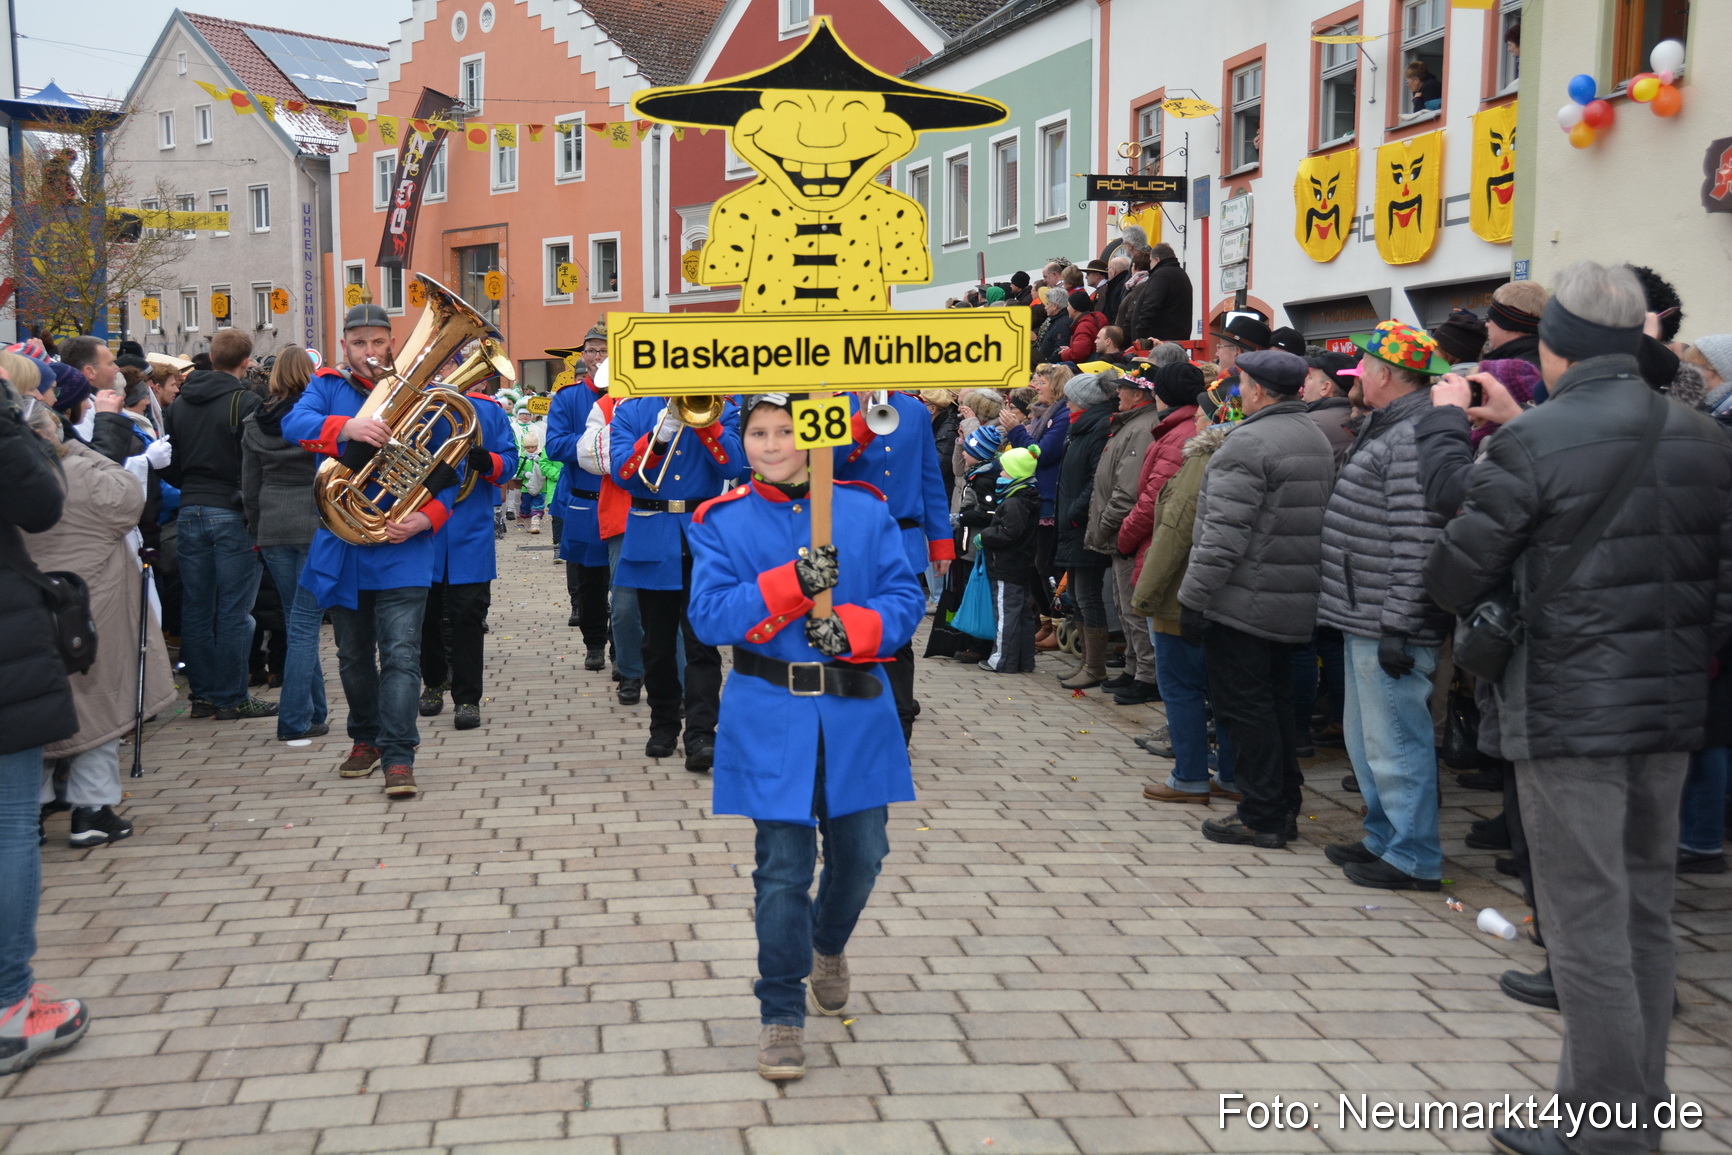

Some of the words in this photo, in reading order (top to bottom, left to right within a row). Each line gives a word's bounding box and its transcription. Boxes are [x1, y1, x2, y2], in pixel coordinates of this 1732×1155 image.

[1097, 178, 1176, 191] RÖHLICH
[303, 204, 313, 262] UHREN
[1516, 262, 1526, 273] 20
[304, 269, 315, 350] SCHMUCK
[633, 338, 831, 376] Blaskapelle
[843, 334, 1003, 367] Mühlbach
[799, 406, 846, 442] 38
